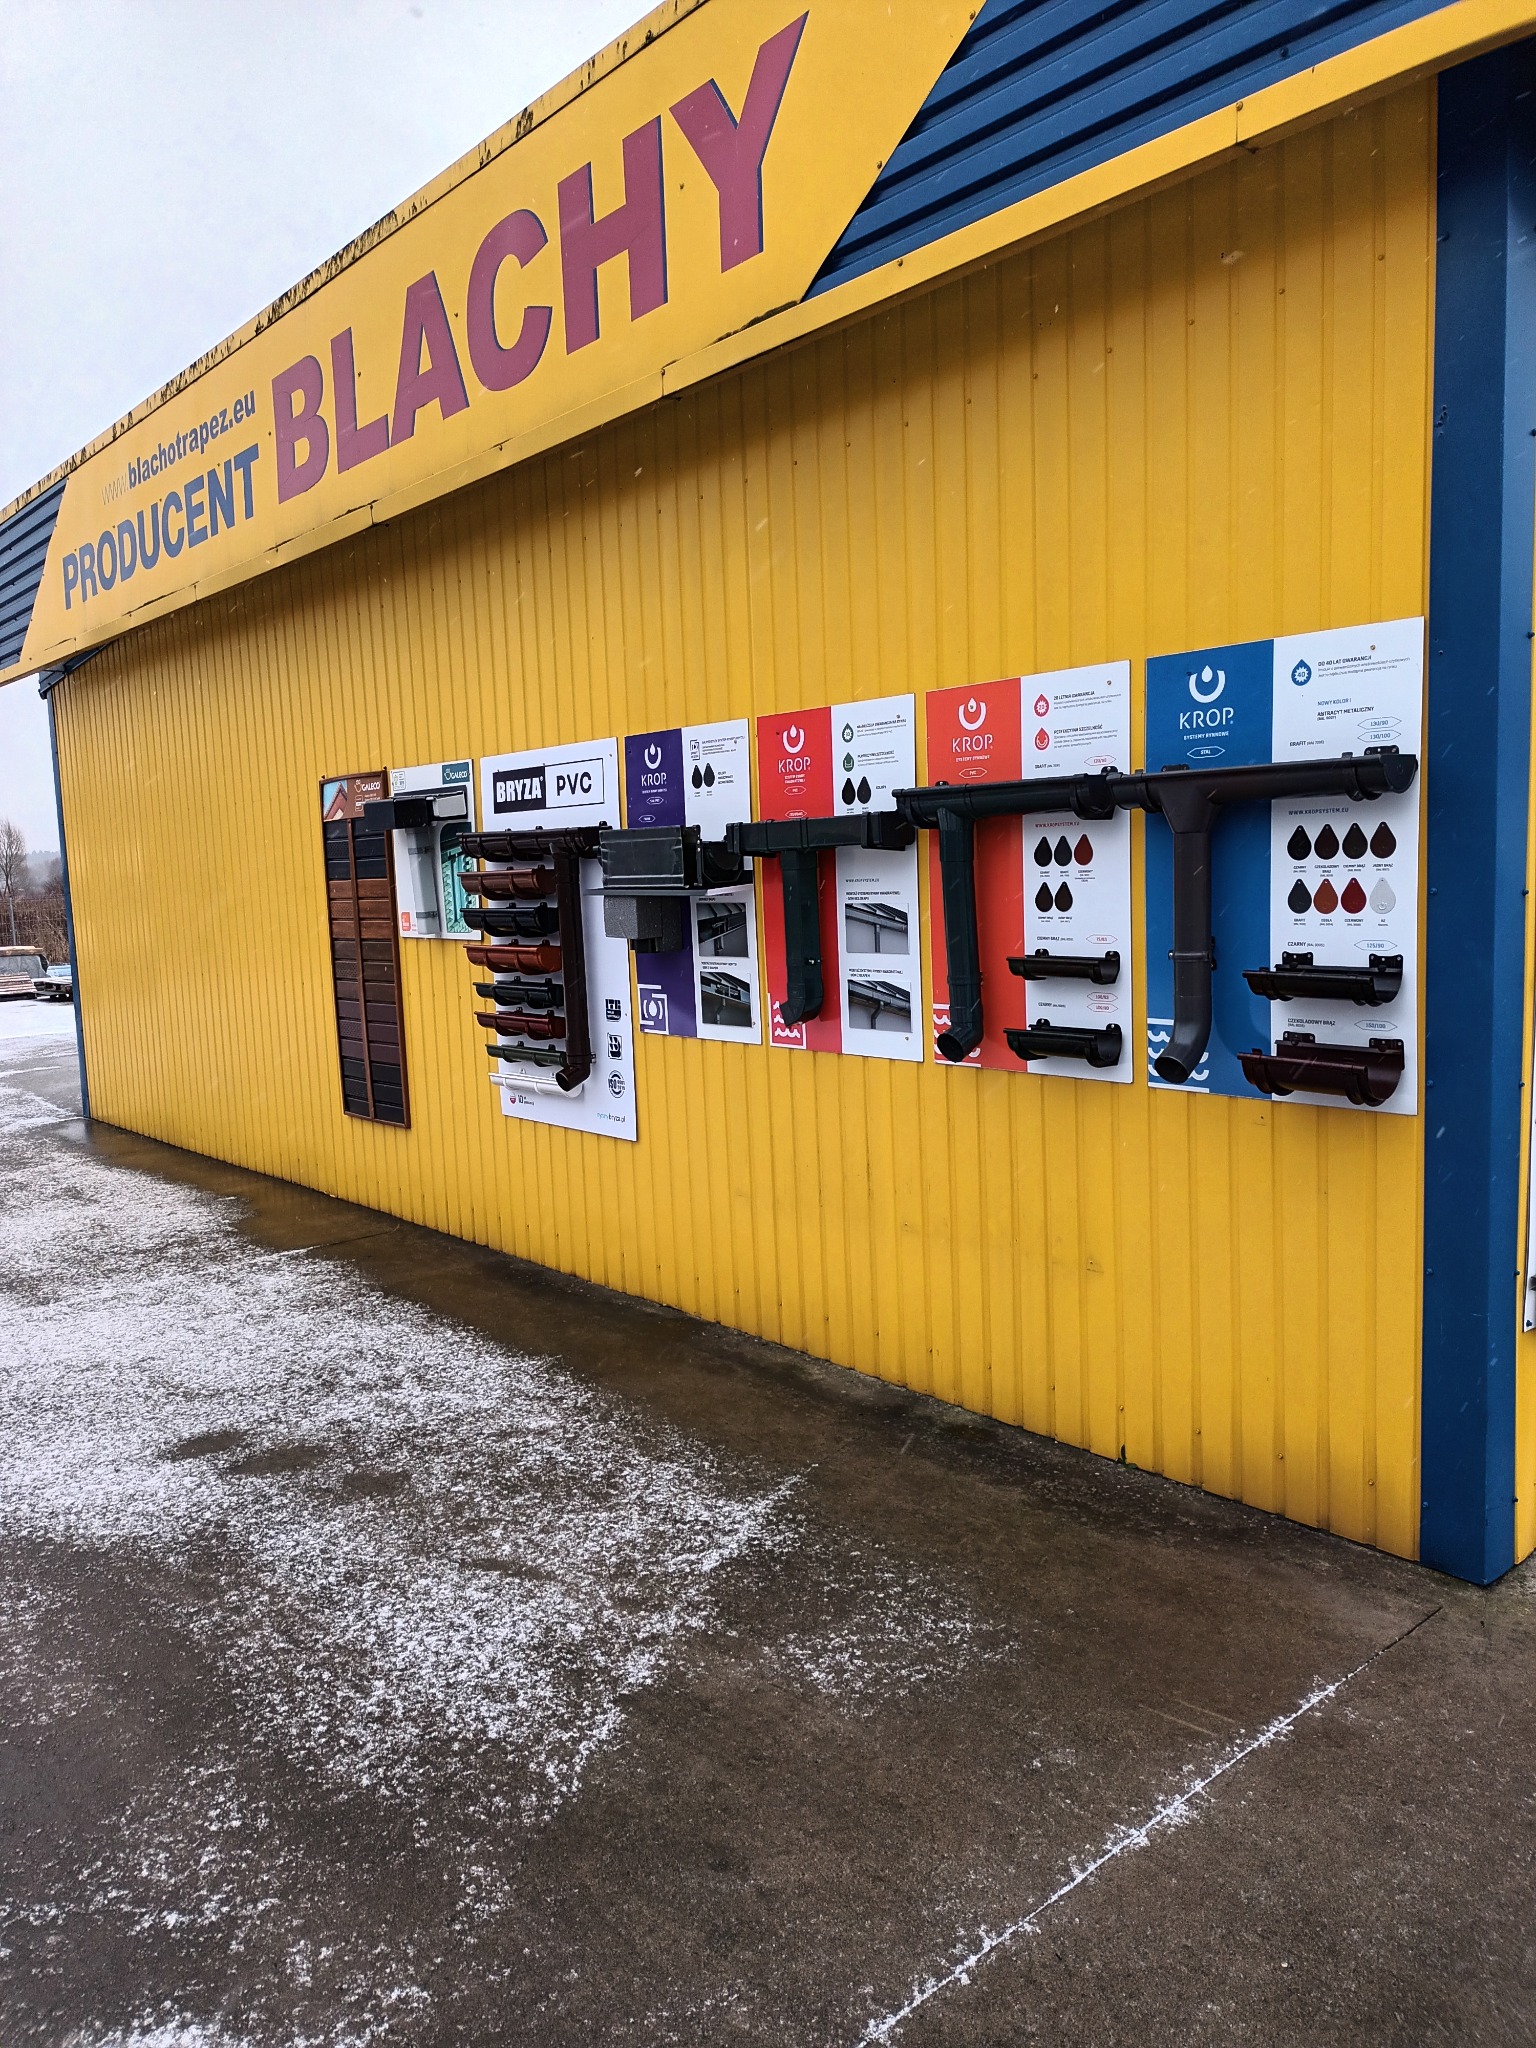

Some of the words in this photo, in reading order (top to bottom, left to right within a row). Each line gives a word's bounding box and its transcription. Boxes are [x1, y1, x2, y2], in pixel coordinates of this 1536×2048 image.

[272, 9, 810, 504] BLACHY
[62, 443, 259, 610] PRODUCENT
[1344, 706, 1374, 714] METALICZNY
[361, 781, 380, 792] GALECO
[556, 771, 592, 796] PVC
[1288, 807, 1349, 816] WWW.KROPSYSTEM.EU
